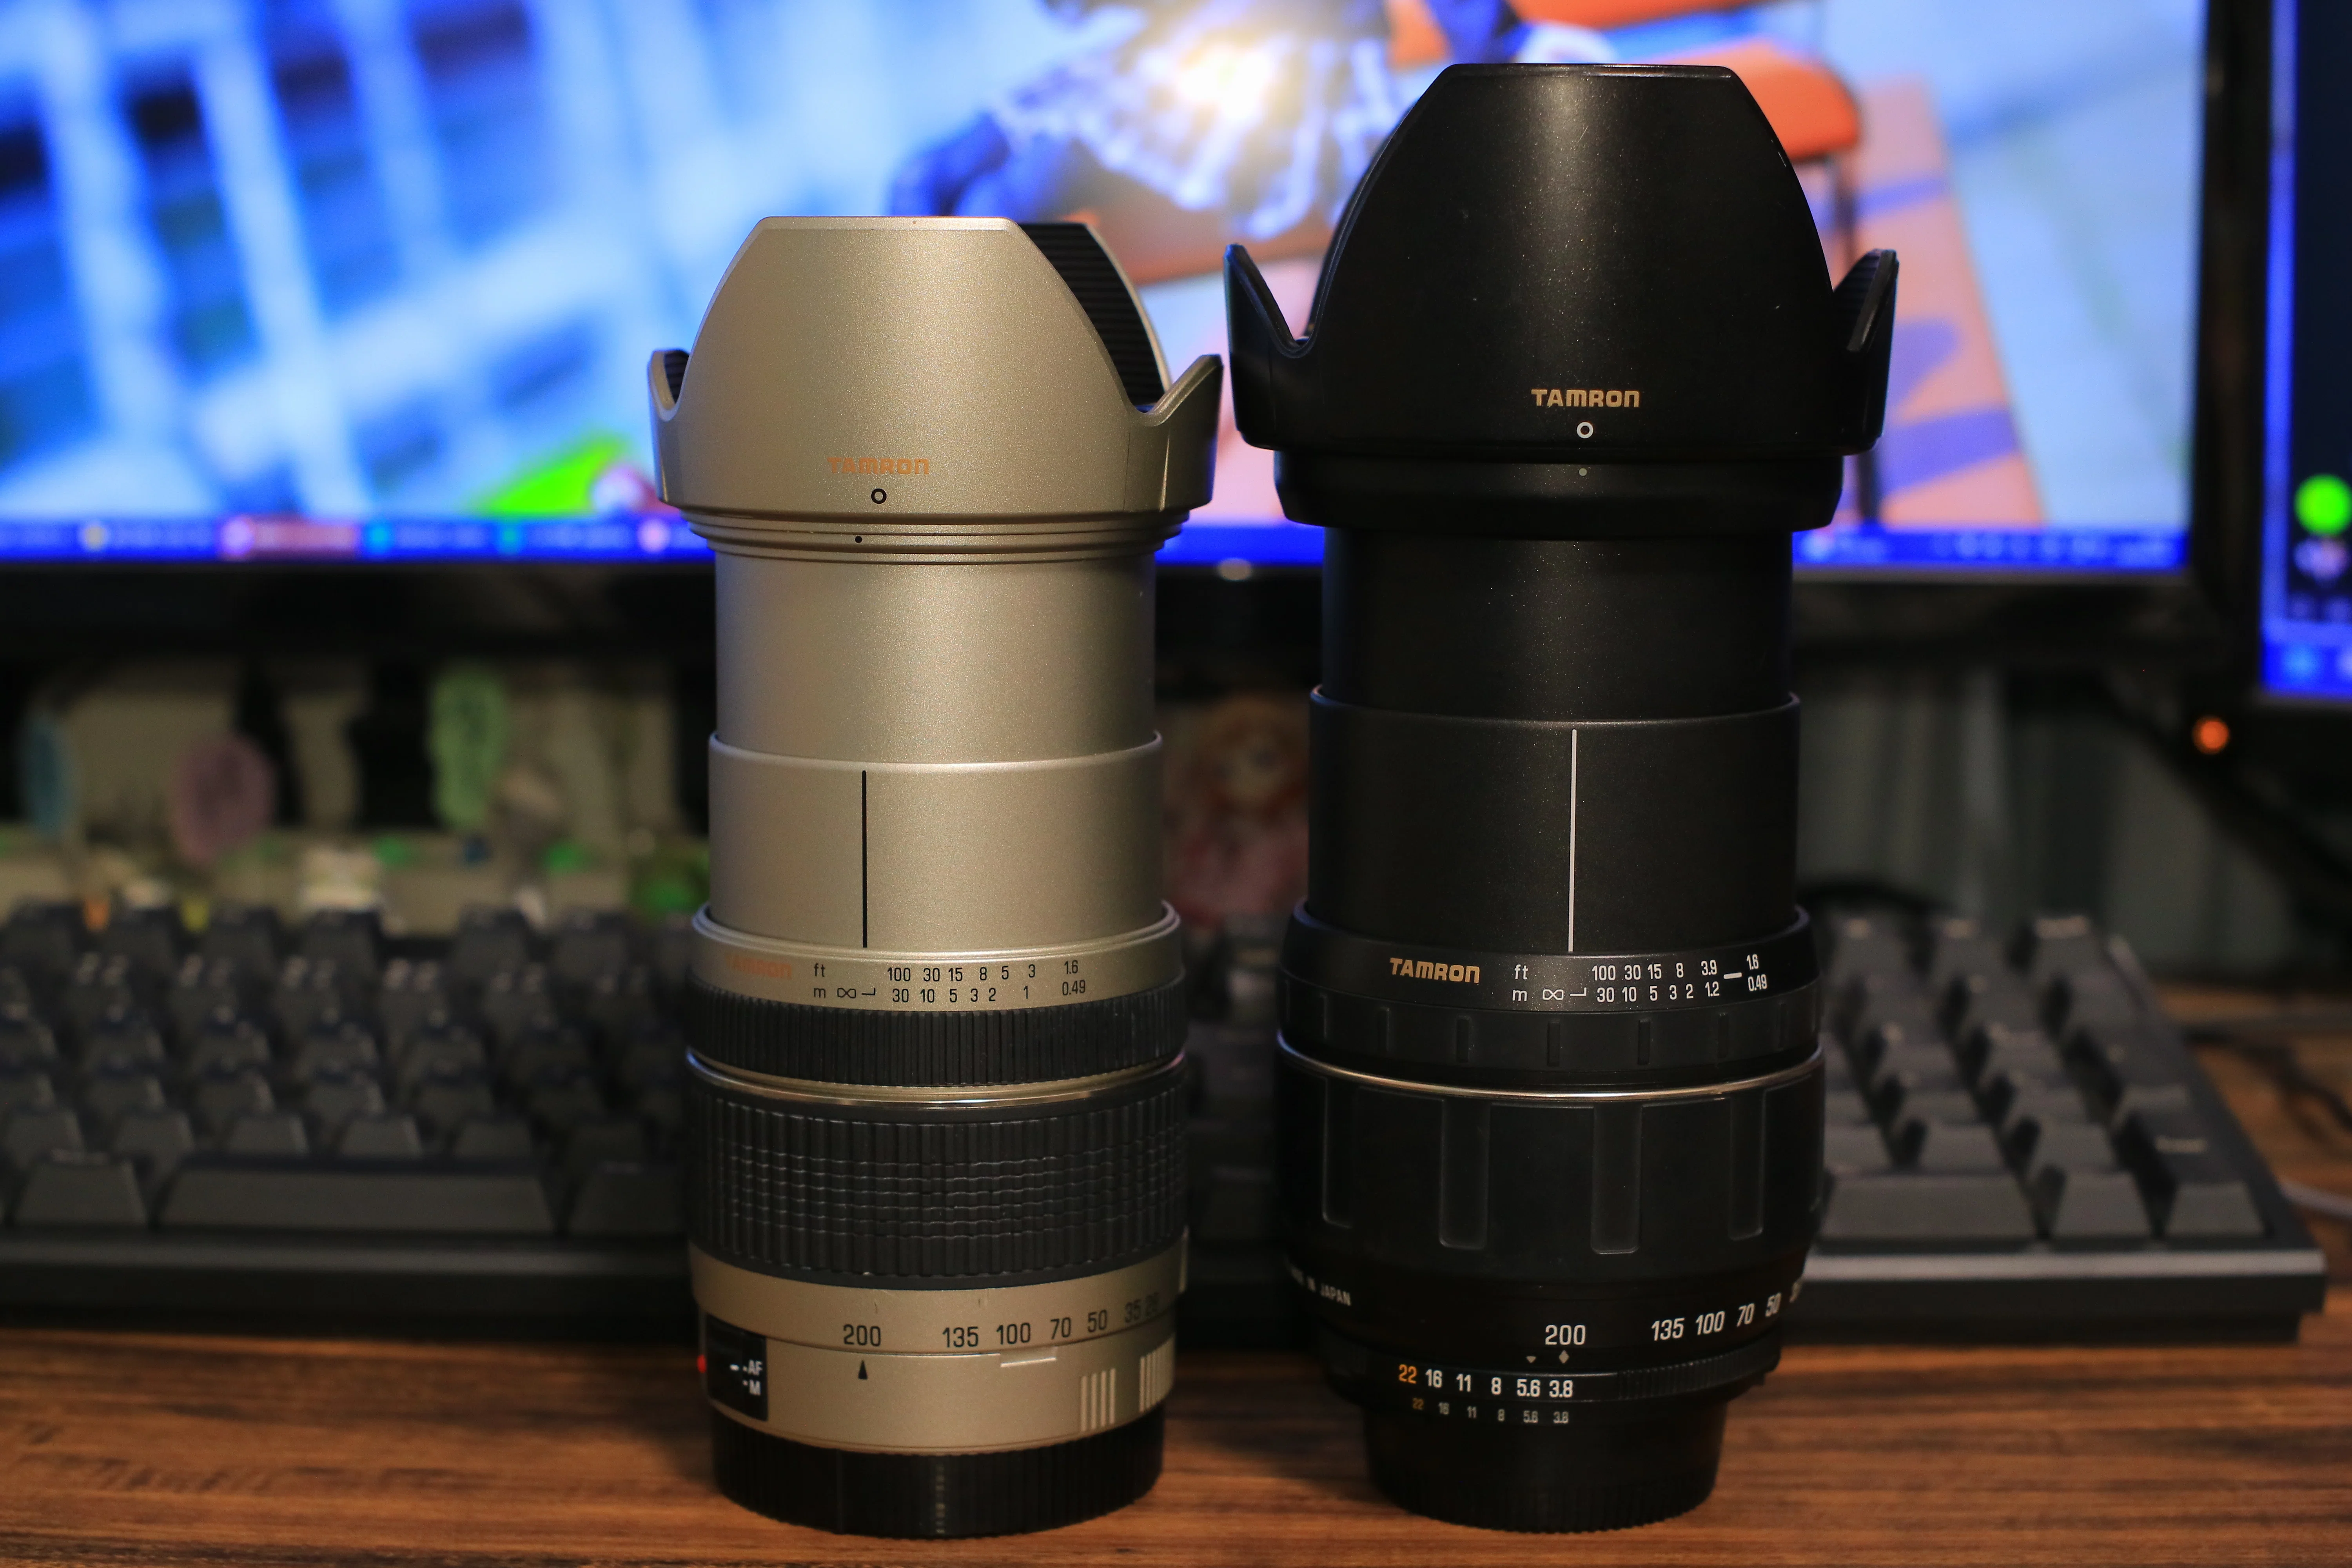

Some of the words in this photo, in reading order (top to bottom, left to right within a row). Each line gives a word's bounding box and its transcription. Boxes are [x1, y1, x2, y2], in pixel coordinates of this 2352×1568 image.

[1531, 389, 1639, 408] TAMRON
[827, 457, 929, 475] TAMRON
[814, 963, 825, 977] ft
[887, 967, 911, 982] 100
[923, 968, 940, 982] 30
[948, 967, 963, 982] 15
[980, 967, 987, 981] 8
[1002, 966, 1009, 980] 5
[1028, 964, 1035, 978] 3
[1064, 960, 1078, 975] 1.6
[1390, 957, 1480, 984] TAMRON
[1514, 964, 1528, 980] ft
[1592, 965, 1616, 981] 100
[1624, 964, 1641, 980] 30
[1647, 964, 1662, 980] 15
[1676, 962, 1684, 978] 8
[1701, 960, 1717, 976] 3.9
[1746, 954, 1759, 970] 1.6
[814, 988, 826, 998] m
[892, 989, 908, 1003] 30
[920, 989, 935, 1003] 10
[950, 989, 957, 1002] 5
[971, 988, 978, 1002] 3
[989, 988, 996, 1001] 2
[1023, 985, 1029, 999] 1
[1062, 980, 1085, 996] 0.49
[1512, 989, 1528, 1002] m
[1597, 987, 1615, 1003] 30
[1622, 986, 1637, 1002] 10
[1650, 985, 1658, 1001] 5
[1669, 984, 1677, 1000] 3
[1686, 983, 1694, 999] 2
[1705, 981, 1720, 997] 1.2
[1748, 974, 1768, 992] 0.49
[843, 1324, 881, 1347] 200
[942, 1326, 979, 1348] 135
[996, 1322, 1031, 1345] 100
[1050, 1317, 1072, 1340] 70
[1087, 1309, 1107, 1333] 50
[1125, 1299, 1142, 1323] 35
[1544, 1324, 1586, 1346] 200
[1651, 1318, 1685, 1341] 135
[1695, 1310, 1725, 1336] 100
[1737, 1303, 1755, 1327] 70
[1765, 1292, 1782, 1318] 50
[748, 1359, 763, 1376] AF
[1398, 1364, 1417, 1384] 22
[1425, 1369, 1443, 1388] 16
[1456, 1373, 1472, 1392] 11
[1491, 1377, 1502, 1395] 8
[1516, 1379, 1541, 1397] 5.6
[1549, 1380, 1573, 1398] 3.8
[749, 1379, 761, 1396] M
[1412, 1397, 1424, 1410] 22
[1438, 1401, 1450, 1416] 16
[1466, 1405, 1477, 1419] 11
[1497, 1409, 1505, 1422] 8
[1523, 1410, 1538, 1424] 5.6
[1553, 1411, 1569, 1424] 3.8
